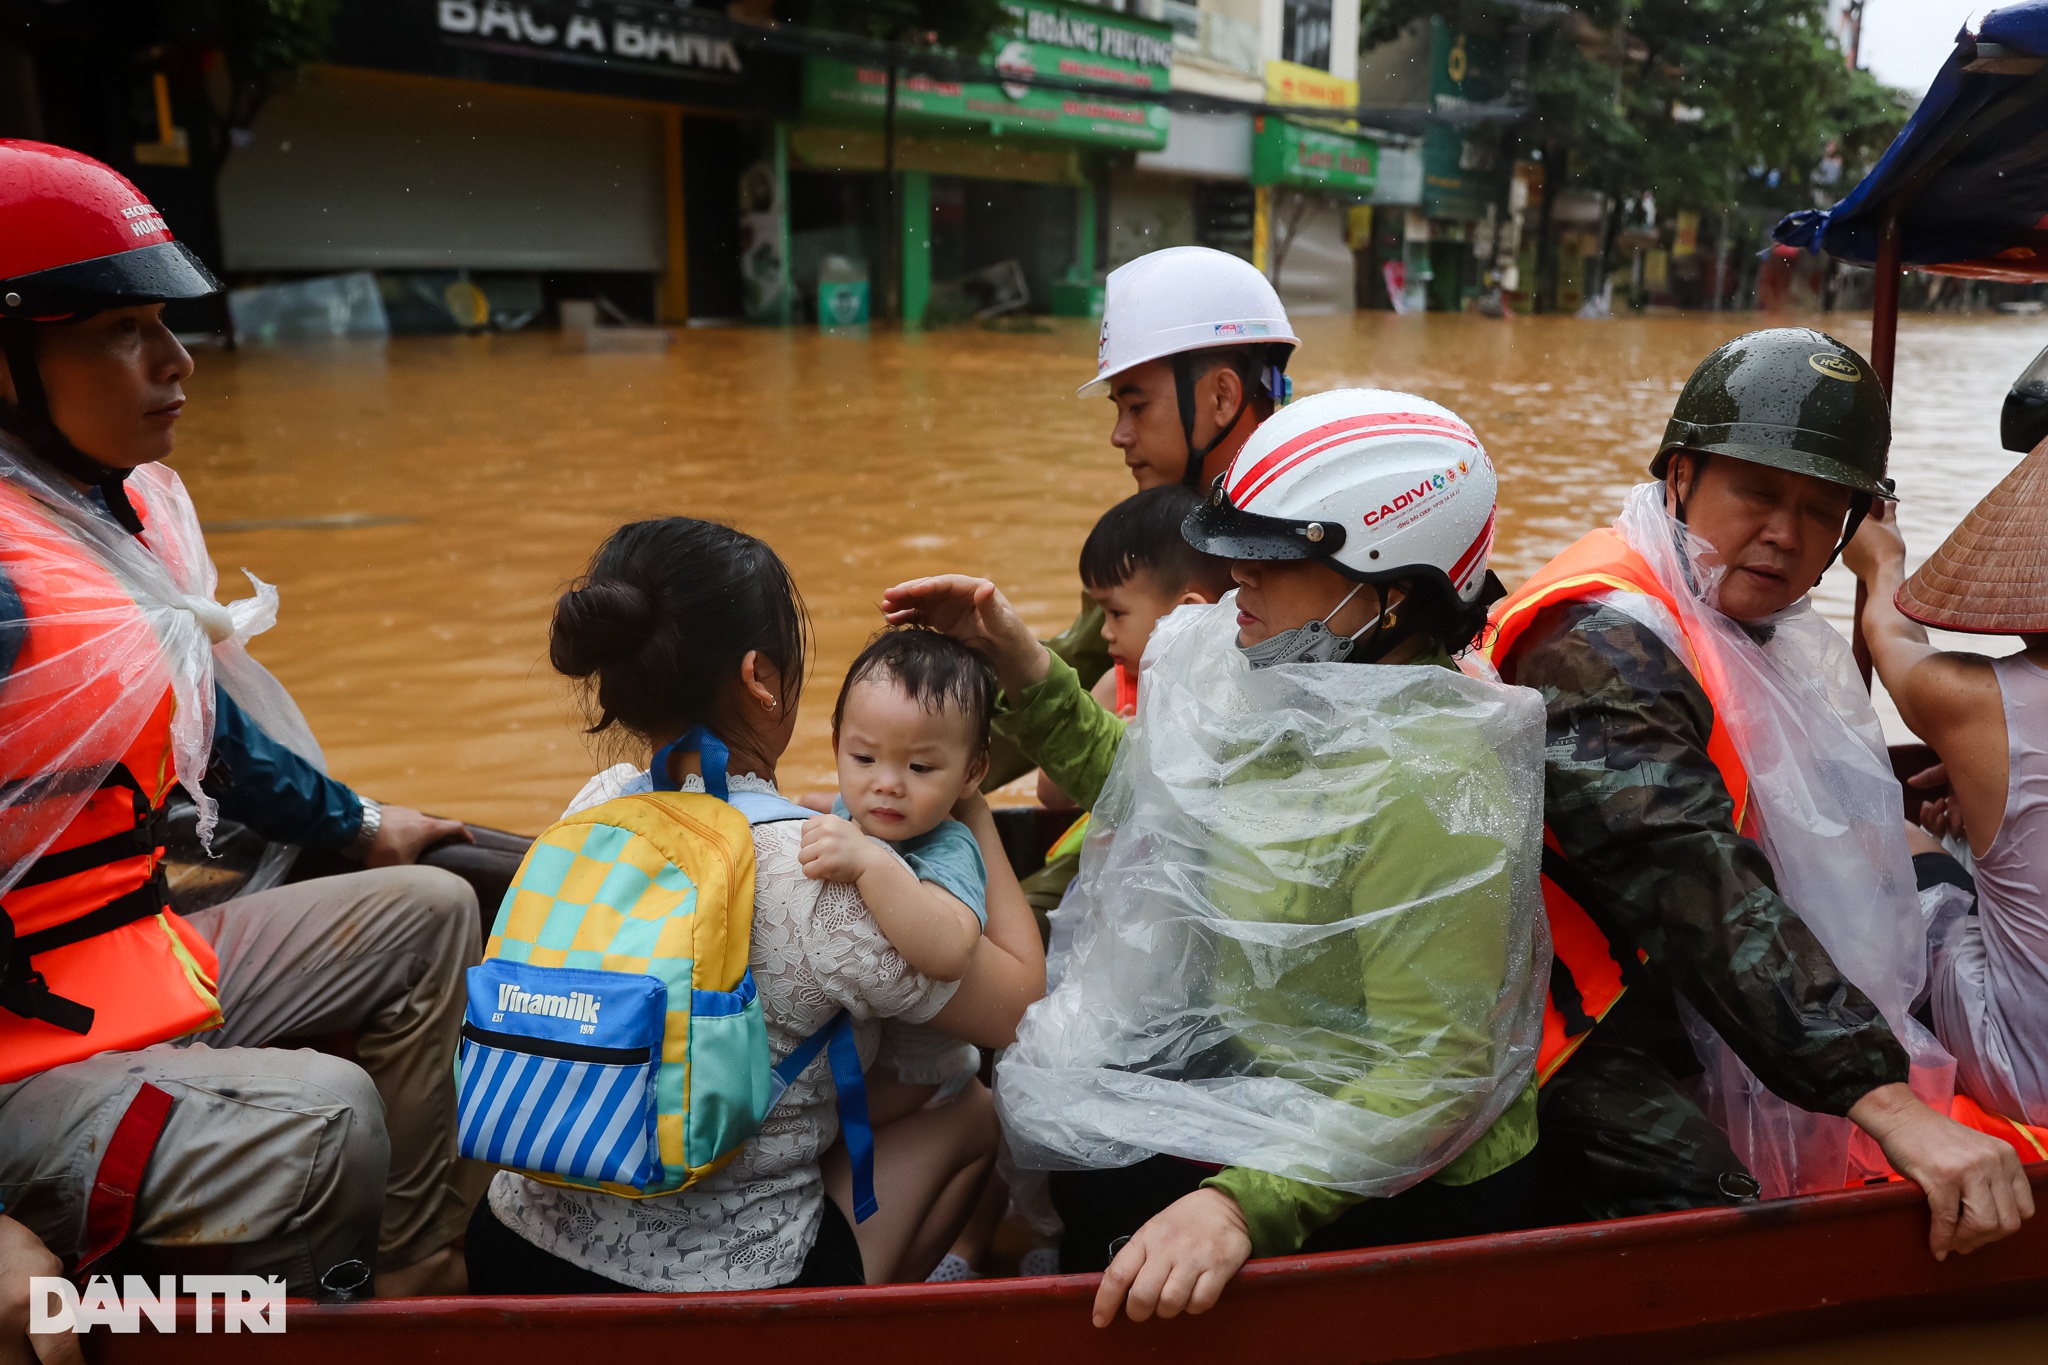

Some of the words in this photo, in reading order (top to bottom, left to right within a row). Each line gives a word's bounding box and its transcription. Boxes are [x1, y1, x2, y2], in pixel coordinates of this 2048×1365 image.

[1363, 480, 1434, 527] CADIVI
[497, 983, 601, 1024] Vinamilk
[491, 1012, 505, 1023] EST
[579, 1023, 596, 1035] 1976
